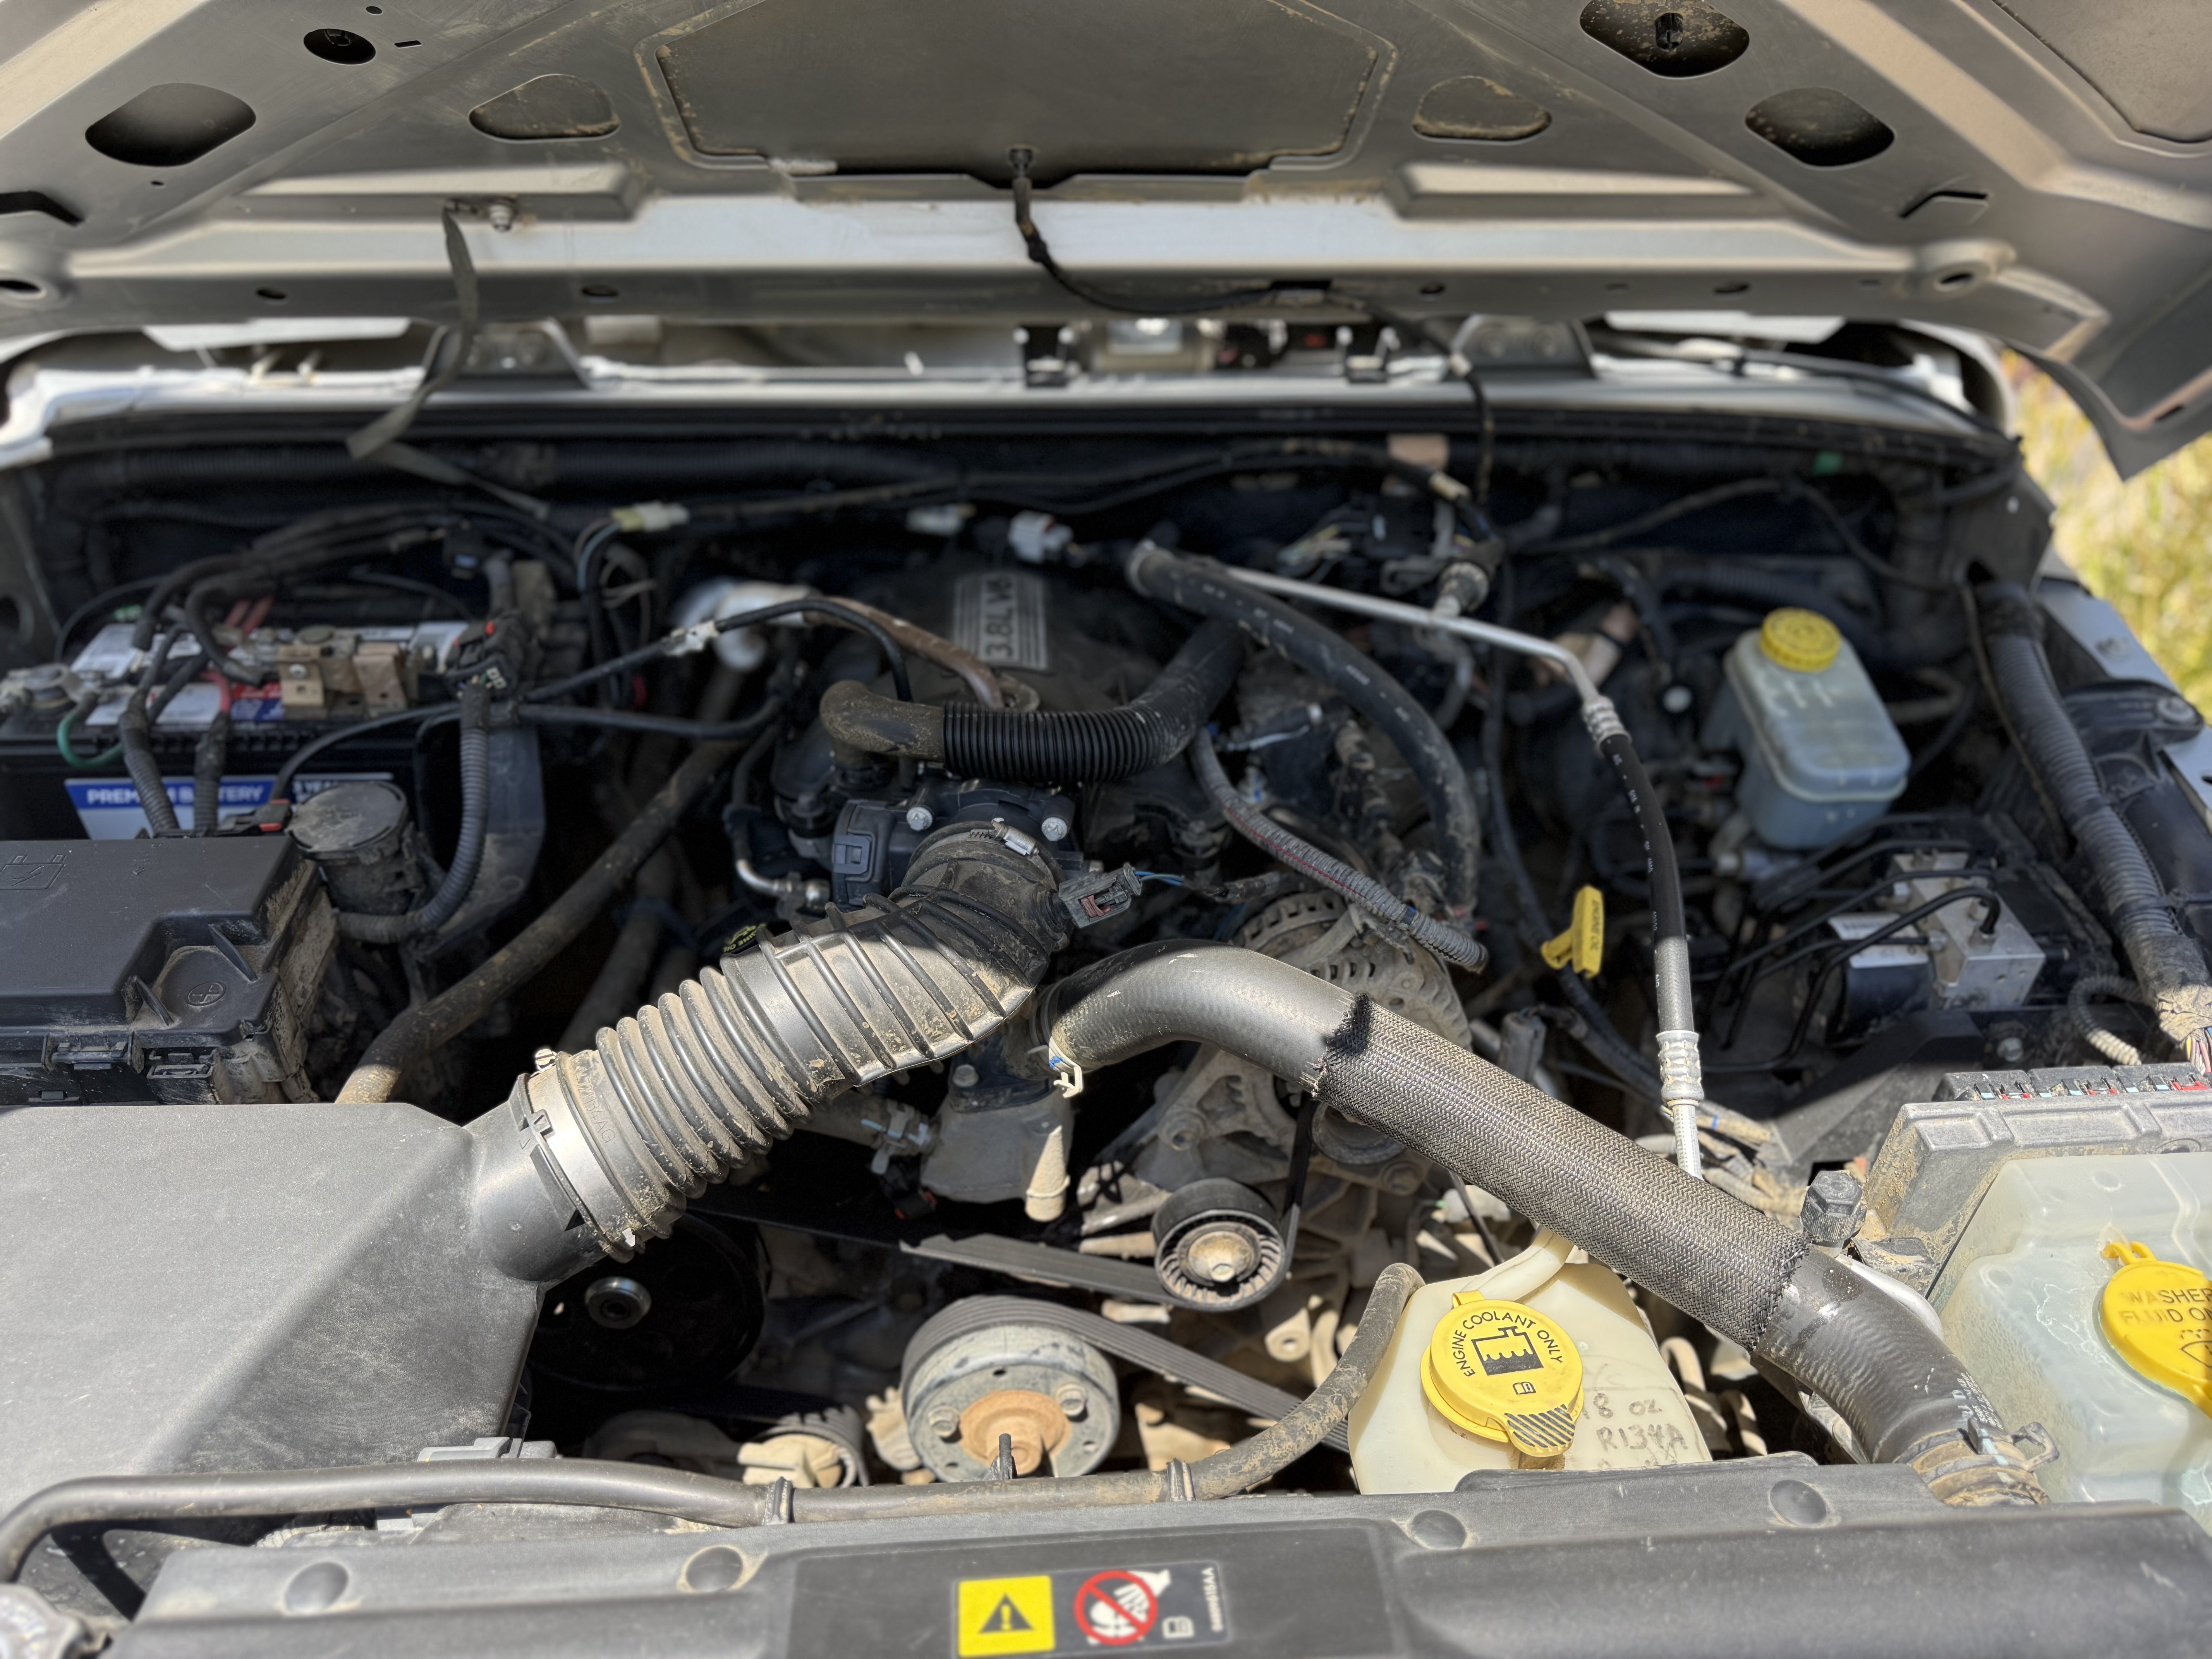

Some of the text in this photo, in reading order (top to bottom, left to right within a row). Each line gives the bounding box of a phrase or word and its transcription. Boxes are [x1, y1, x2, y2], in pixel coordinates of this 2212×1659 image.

[87, 785, 264, 804] PREMM BTERY
[2118, 1309, 2183, 1324] FLUID
[1452, 1311, 1563, 1377] ENGINE COOLANT ONLY
[1595, 1423, 1688, 1453] R134A
